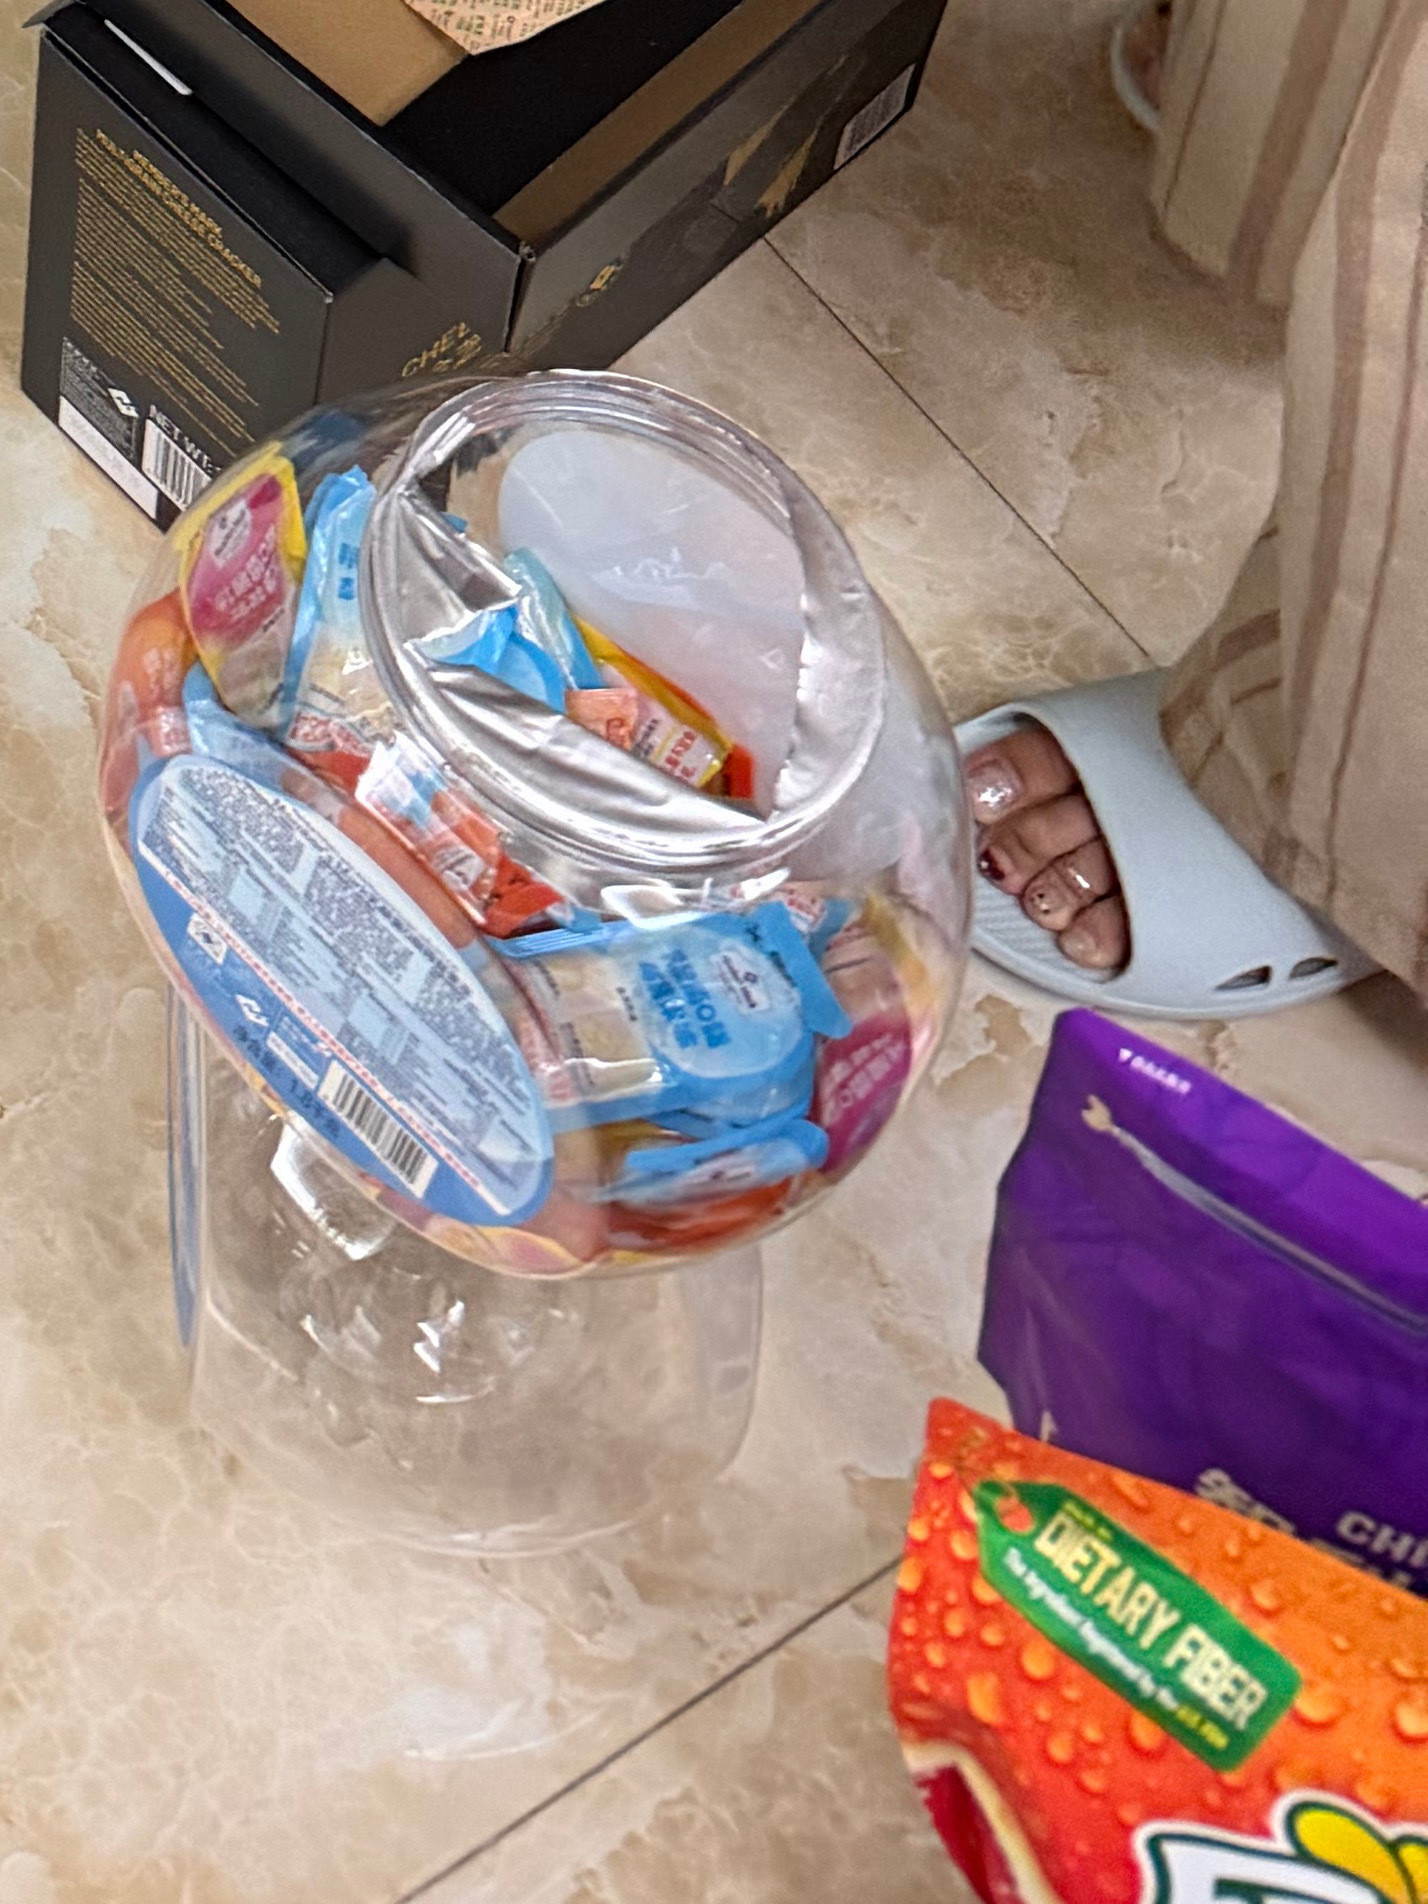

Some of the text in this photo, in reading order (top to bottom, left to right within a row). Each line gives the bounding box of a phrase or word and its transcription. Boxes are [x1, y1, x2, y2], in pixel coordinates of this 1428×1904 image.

[150, 403, 182, 441] NET
[1033, 1509, 1181, 1651] DIETARY
[1161, 1623, 1268, 1730] FIBER
